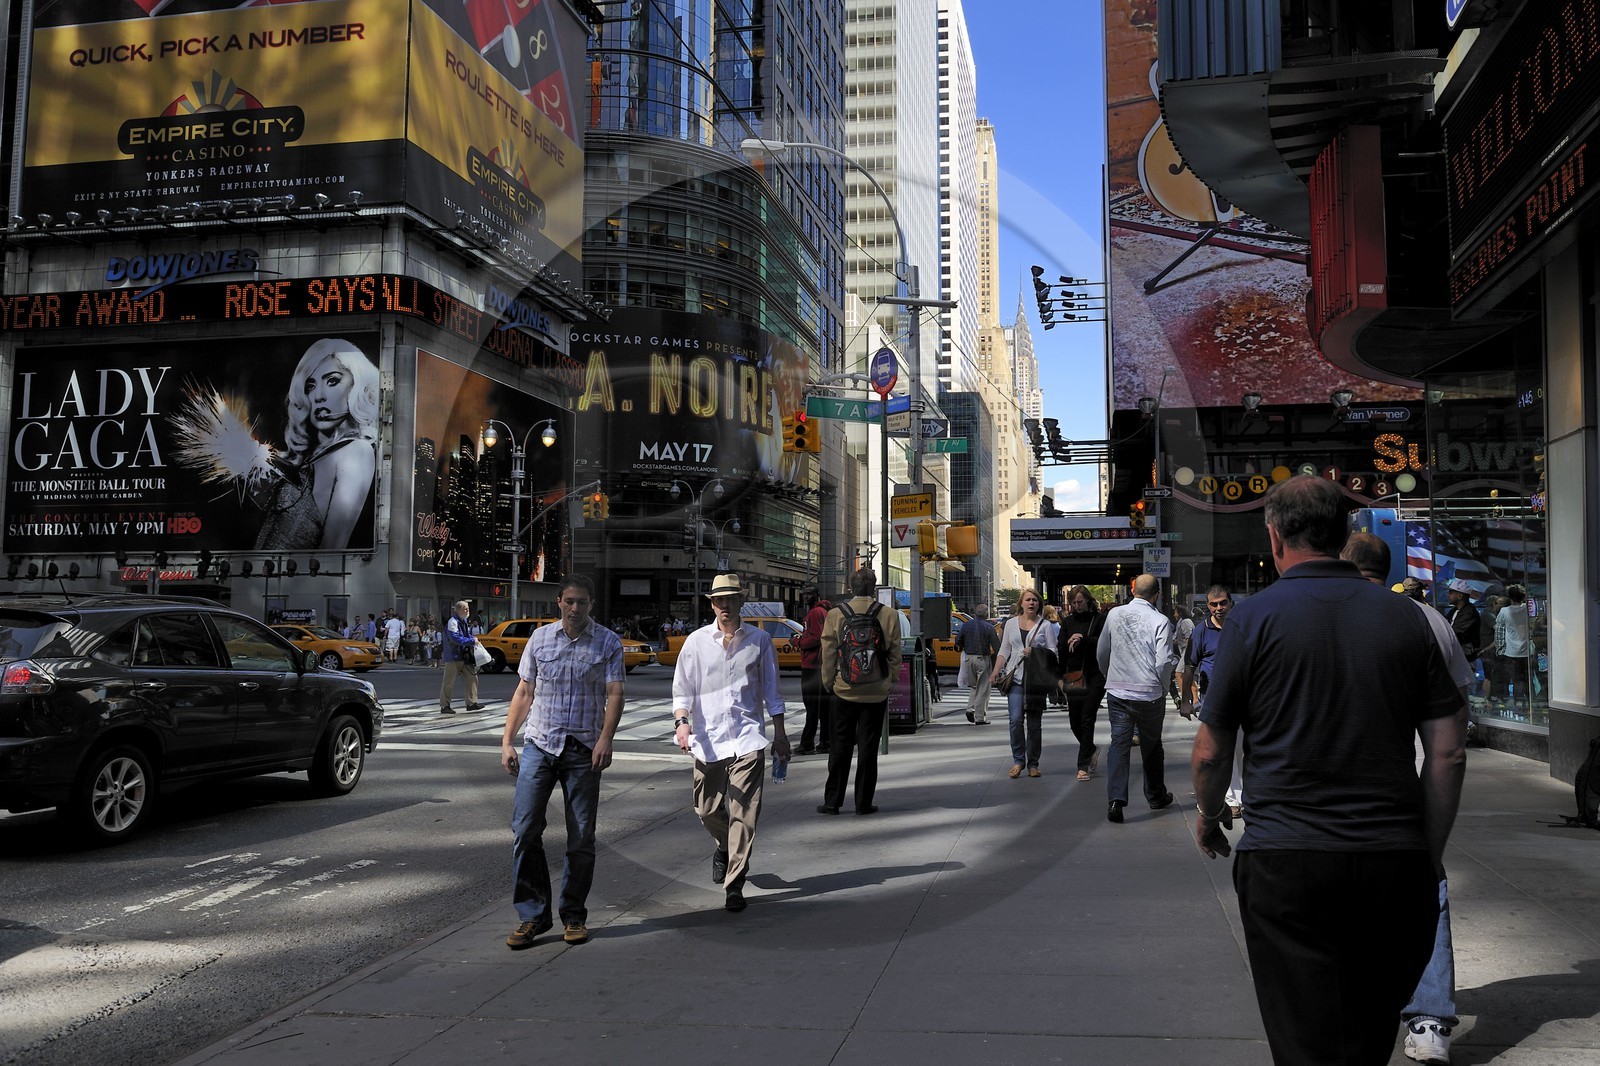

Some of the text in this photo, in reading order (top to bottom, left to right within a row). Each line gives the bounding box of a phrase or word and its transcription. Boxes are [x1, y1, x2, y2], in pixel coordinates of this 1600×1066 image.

[69, 22, 365, 67] QUICK, PICK A NUMBER
[445, 48, 565, 169] ROULETTE IS HERE
[172, 144, 246, 163] CASINO
[146, 163, 270, 181] YONKERS RACEWAY
[220, 175, 346, 191] EMPIRECITYGAMING.COM
[1525, 143, 1587, 236] POINT
[74, 184, 200, 201] EXIT 2 NY STATE THRUWAY
[492, 194, 524, 226] CASINO
[0, 294, 61, 329] YEAR
[76, 290, 164, 326] AWARD
[225, 281, 291, 318] ROSE
[307, 276, 375, 314] SAYS
[433, 290, 483, 343] STREET
[487, 320, 537, 369] JOURNAL
[649, 336, 700, 349] GAMES
[706, 341, 759, 361] PRESENTS
[17, 366, 172, 420] LADY
[650, 353, 774, 436] NOIRE
[834, 402, 846, 416] 7
[14, 418, 167, 471] GAGA
[639, 441, 713, 463] MAY 17
[940, 440, 949, 451] 7
[632, 463, 719, 473] ROCKSTARGAMES.COM/LANOIRE
[1302, 465, 1313, 475] S
[12, 478, 166, 492] THE MONSTER BALL TOUR
[1203, 480, 1214, 492] N
[1227, 484, 1239, 497] Q
[1253, 479, 1264, 491] R
[1352, 478, 1361, 490] 2
[1377, 483, 1387, 495] 3
[893, 497, 918, 507] TURNING
[9, 511, 166, 523] THE CONCERT EVENT
[894, 506, 918, 515] VEHICLES
[8, 521, 165, 537] SATURDAY, MAY 7 9PM
[166, 517, 202, 534] HBO
[908, 528, 916, 536] TO
[417, 548, 436, 562] open
[437, 548, 453, 568] 24
